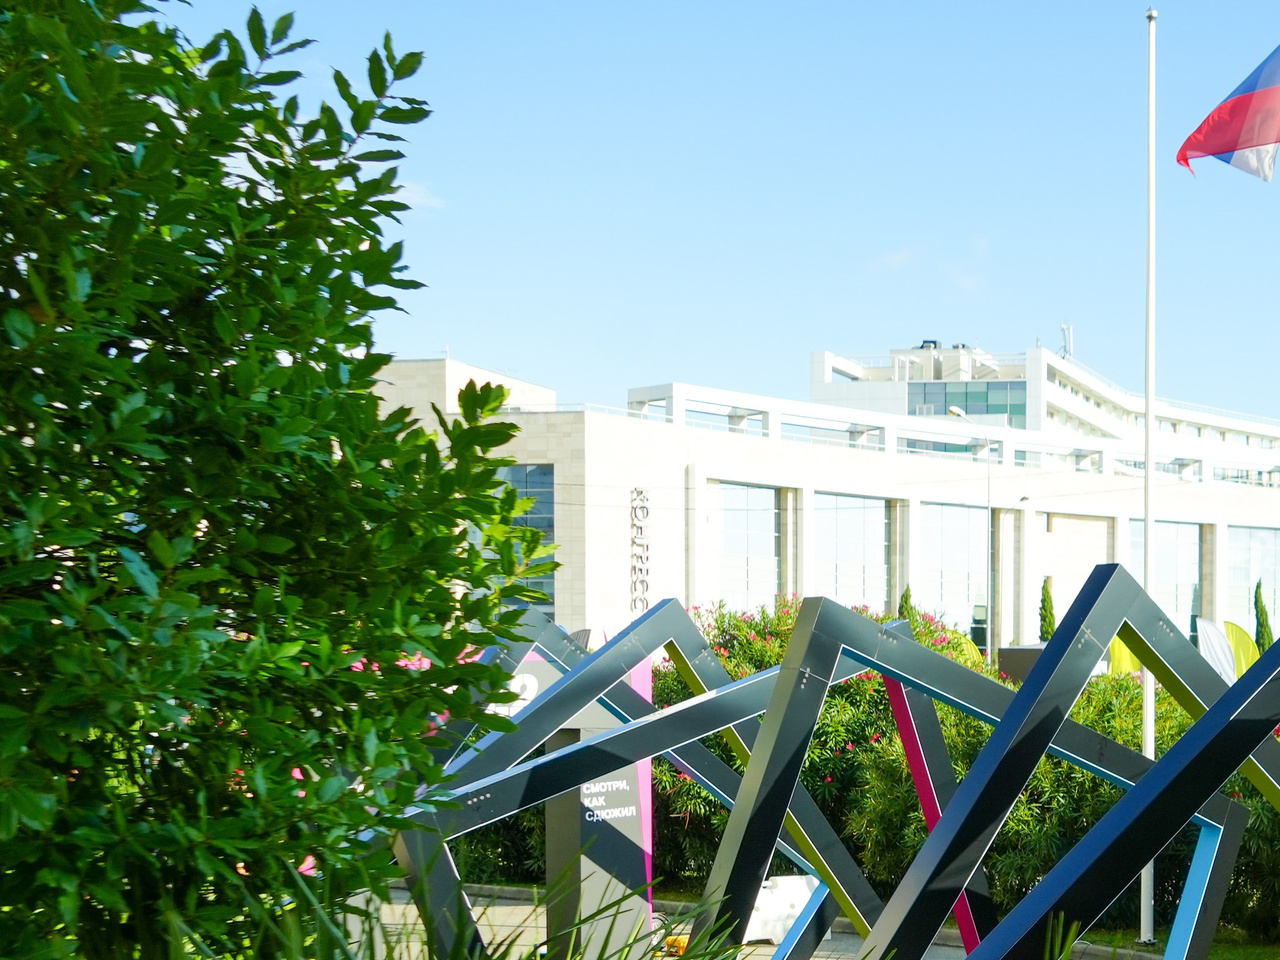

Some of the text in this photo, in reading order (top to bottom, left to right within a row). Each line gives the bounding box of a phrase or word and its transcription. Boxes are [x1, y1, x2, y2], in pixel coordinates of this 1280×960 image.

[583, 780, 630, 794] СМОТРИ,
[584, 796, 606, 807] КАК
[585, 806, 636, 822] СДЮЖИЛ
